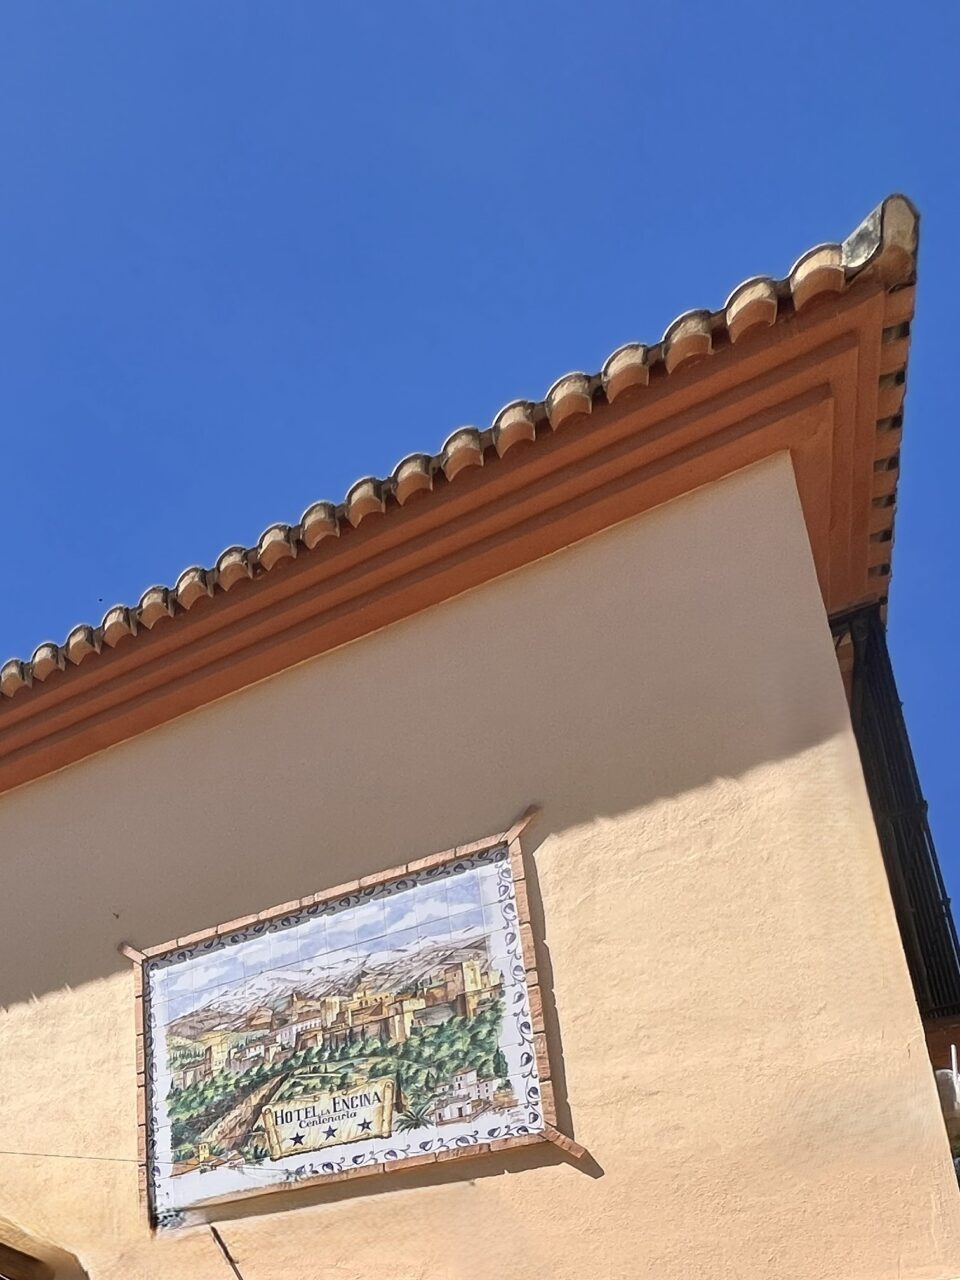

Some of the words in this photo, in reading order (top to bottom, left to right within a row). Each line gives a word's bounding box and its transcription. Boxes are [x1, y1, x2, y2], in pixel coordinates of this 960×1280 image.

[274, 1105, 319, 1126] HOTEL
[321, 1108, 331, 1116] LA
[332, 1091, 382, 1113] ENCINA
[298, 1110, 357, 1129] Centenaria
